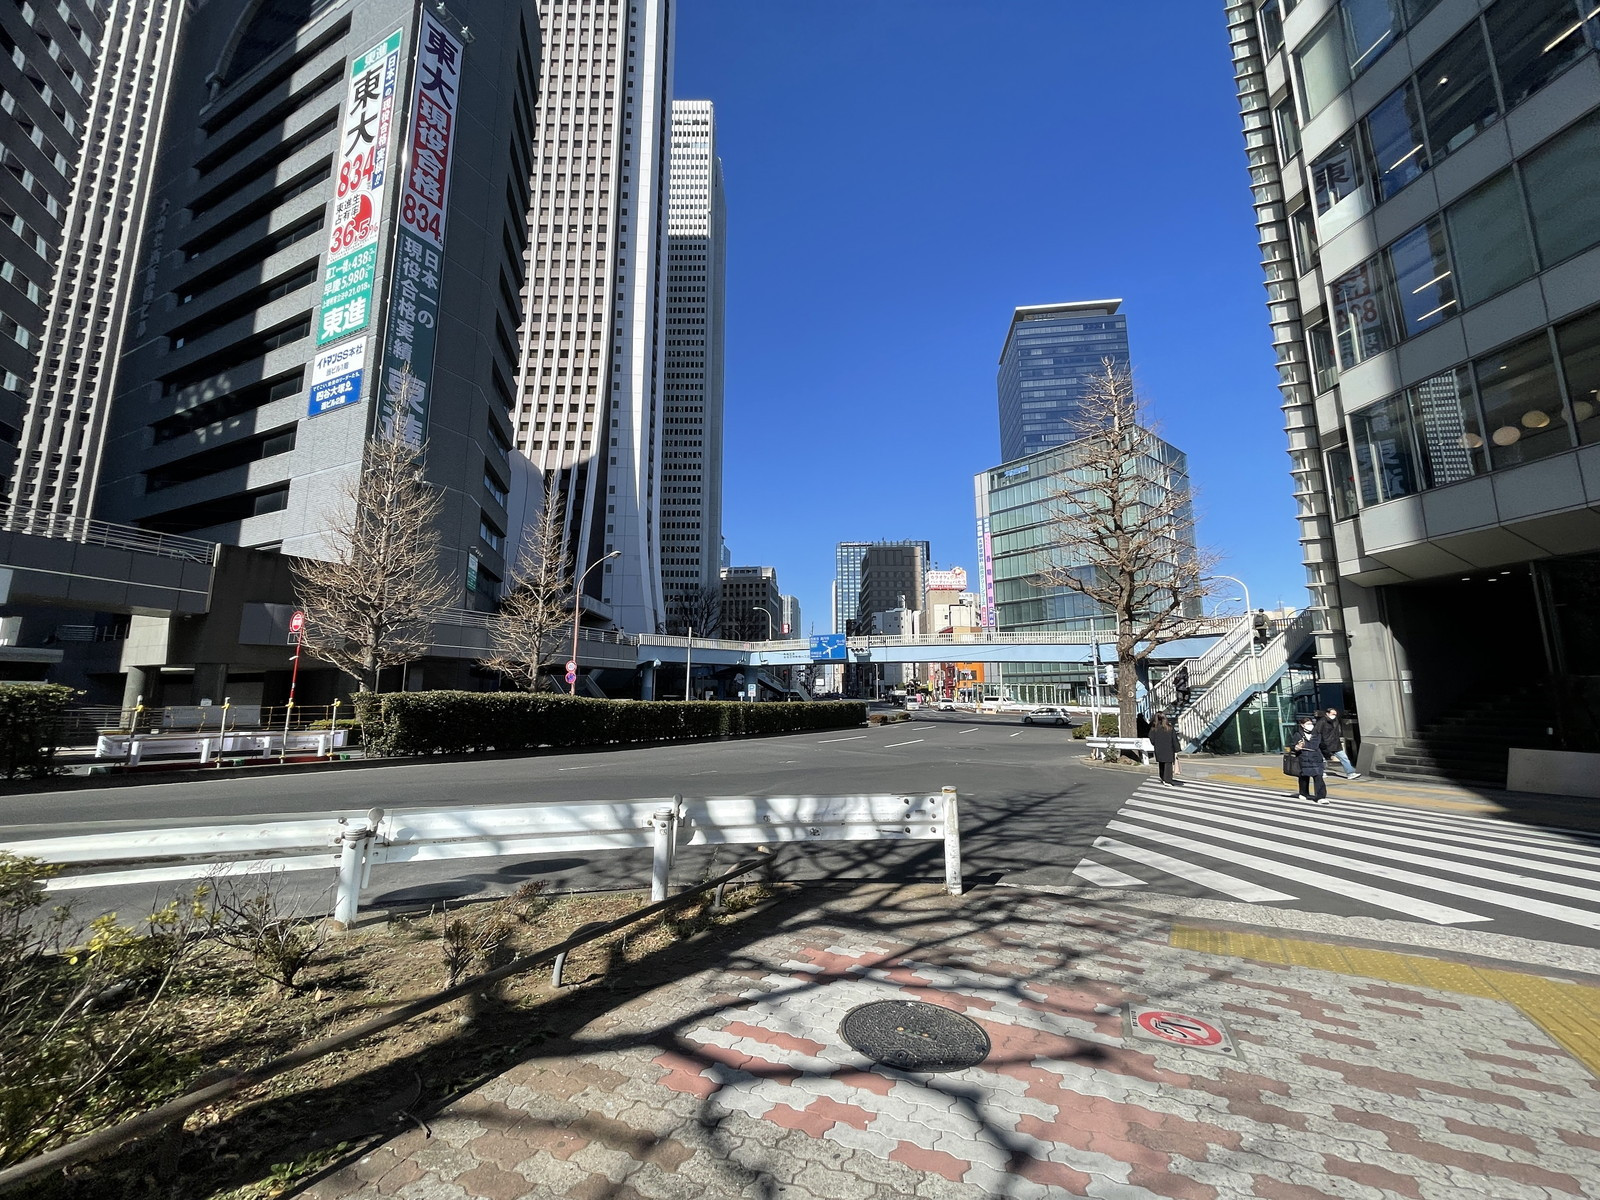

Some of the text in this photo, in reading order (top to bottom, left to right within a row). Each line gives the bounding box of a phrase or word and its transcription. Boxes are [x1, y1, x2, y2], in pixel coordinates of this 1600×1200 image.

[345, 64, 385, 157] 東大
[402, 21, 459, 243] 東大 現役合格 834
[337, 146, 375, 198] 834
[321, 296, 367, 341] 東進
[393, 236, 423, 364] 現役合格実績
[417, 249, 440, 329] 日本一の
[316, 343, 363, 370] イトマンSS本社
